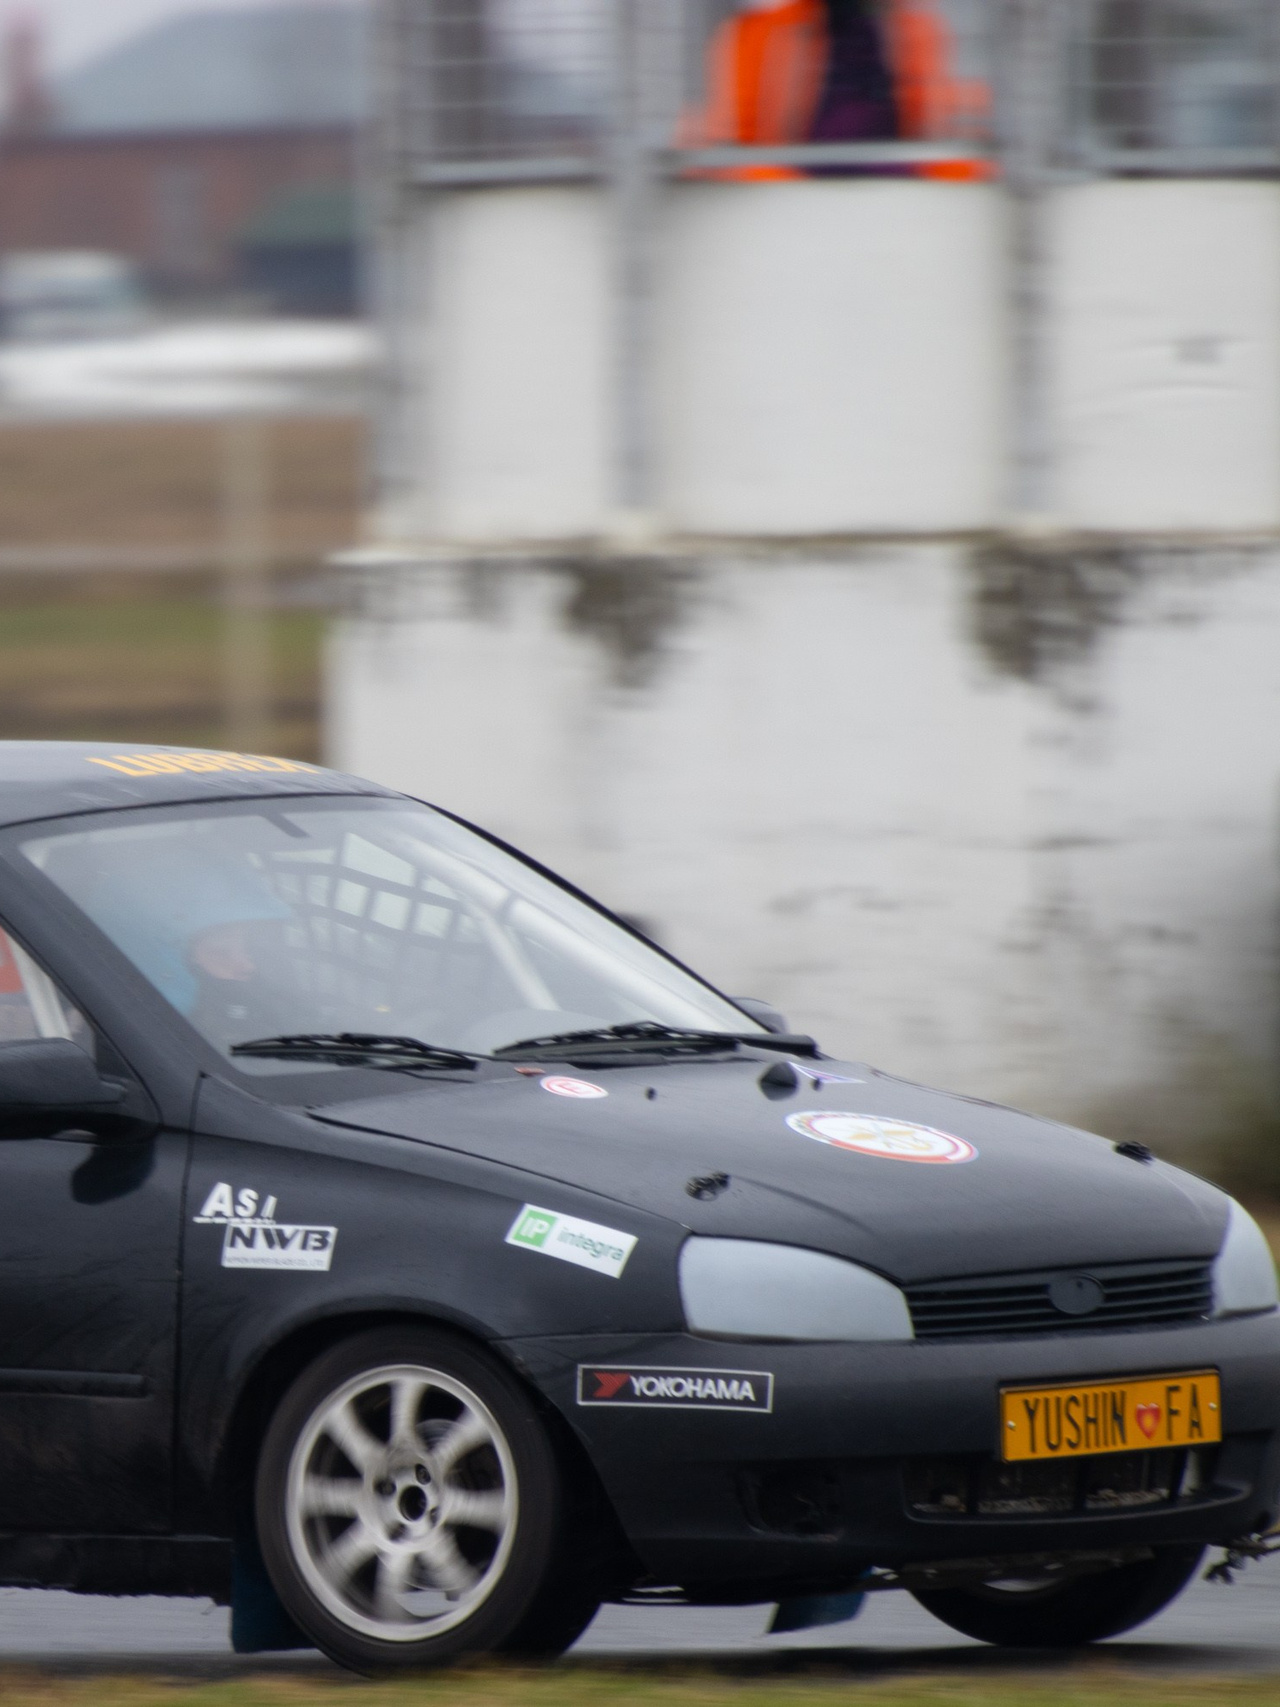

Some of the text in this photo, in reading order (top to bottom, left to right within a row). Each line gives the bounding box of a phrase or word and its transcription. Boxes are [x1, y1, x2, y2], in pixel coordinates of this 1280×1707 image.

[85, 752, 322, 777] LUBREX
[199, 1181, 278, 1219] ASI
[229, 1225, 332, 1251] NWB
[557, 1225, 625, 1262] integra
[630, 1375, 757, 1402] YOKOHAMA
[1023, 1383, 1204, 1454] YUSHIN FA
